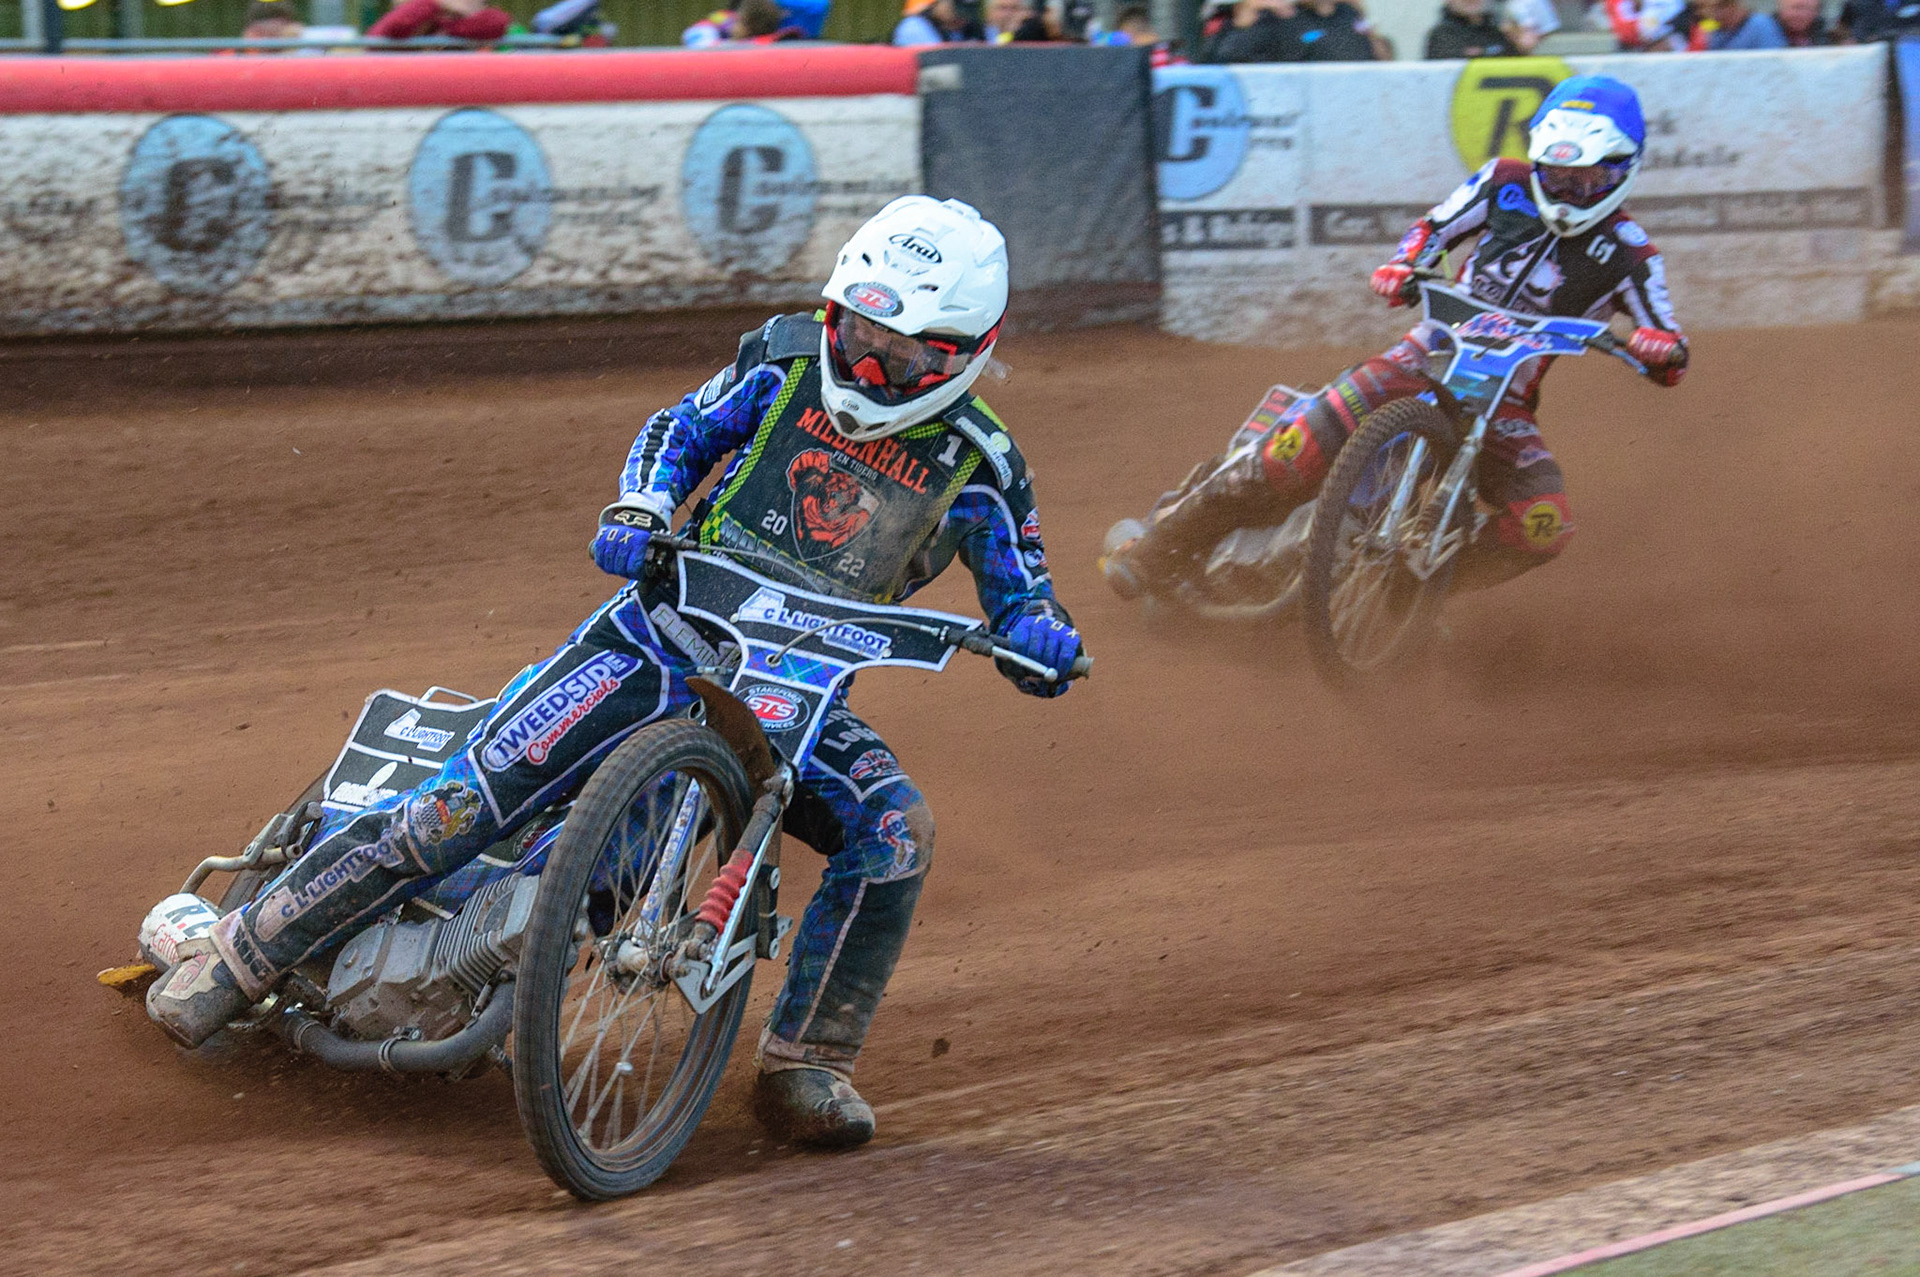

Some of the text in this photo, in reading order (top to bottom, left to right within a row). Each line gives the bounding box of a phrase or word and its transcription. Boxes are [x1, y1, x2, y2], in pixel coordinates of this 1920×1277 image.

[937, 434, 963, 468] 1
[832, 450, 879, 481] FEN TIGERS
[599, 526, 635, 544] FOX
[761, 509, 788, 536] 20
[837, 552, 865, 578] 22
[763, 607, 776, 620] C
[778, 610, 790, 624] L
[494, 652, 629, 760] TWEEDSIDE
[748, 697, 795, 718] STS
[527, 678, 619, 763] Commercials
[413, 726, 452, 744] LIGHTFOOT
[281, 904, 295, 918] C
[307, 840, 392, 898] LIGHTFOO
